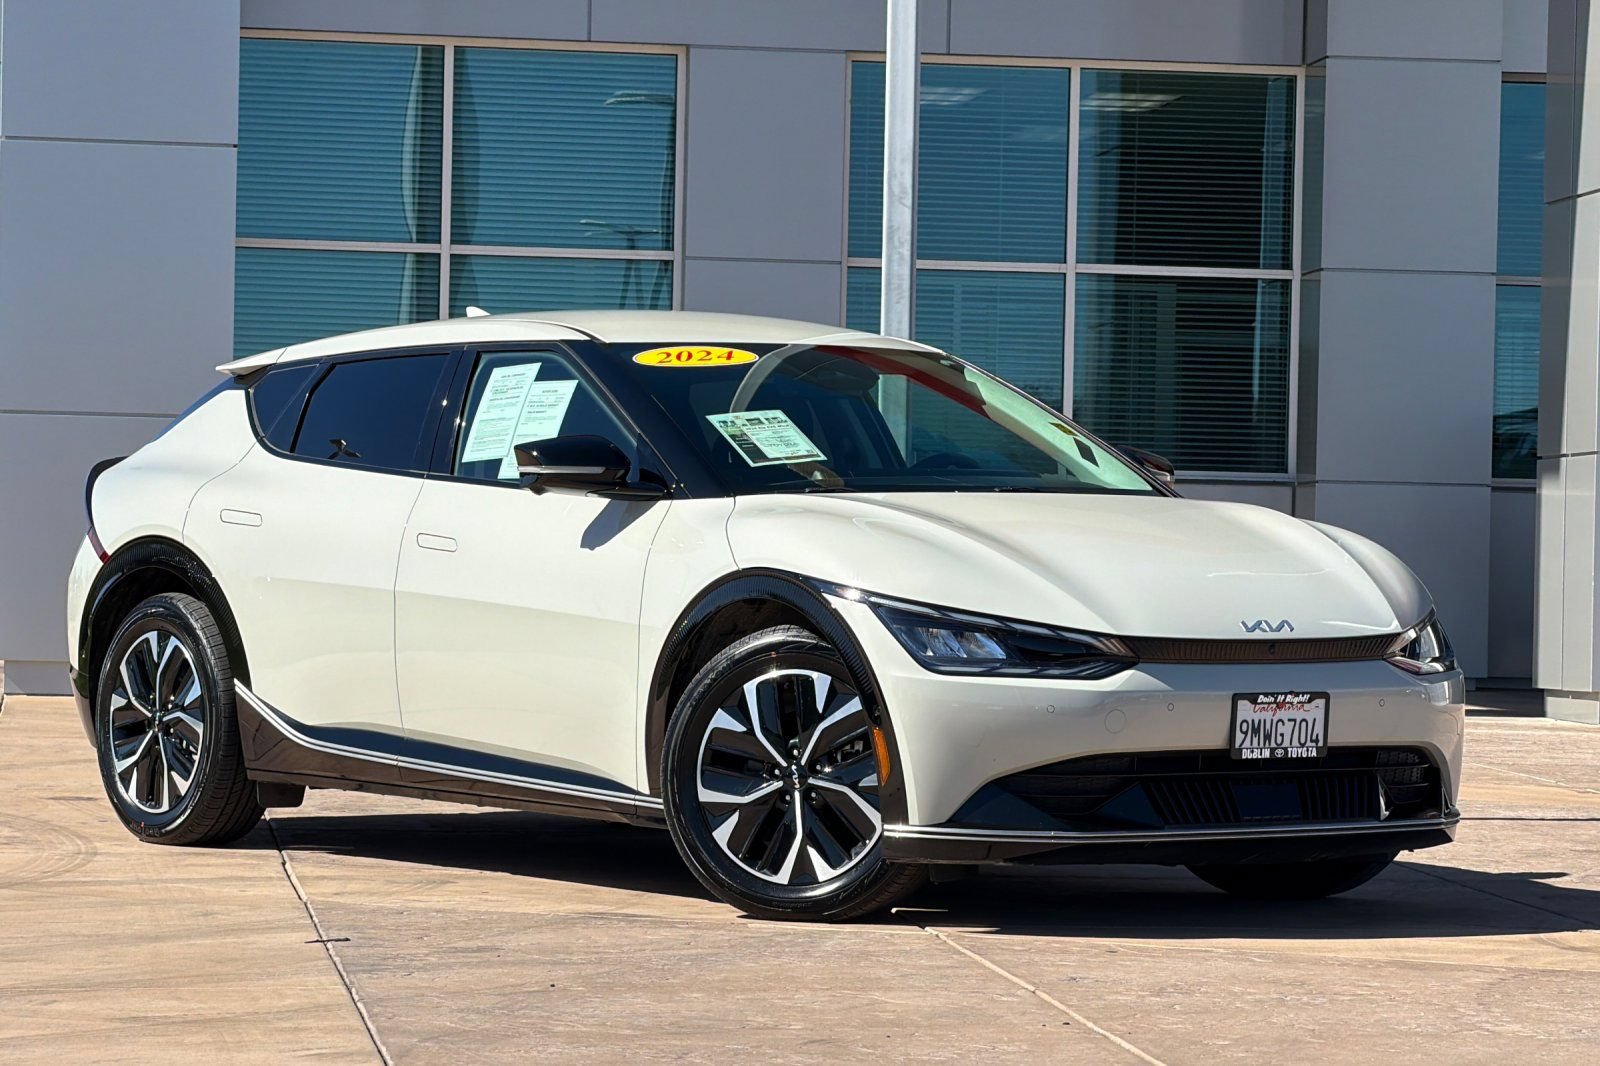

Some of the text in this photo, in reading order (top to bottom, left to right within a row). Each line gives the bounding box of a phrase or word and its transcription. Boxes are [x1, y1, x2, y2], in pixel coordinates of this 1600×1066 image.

[656, 349, 735, 364] 2024
[1277, 694, 1284, 702] It
[1285, 694, 1310, 705] Right!
[1239, 717, 1320, 748] 9MWG704
[1241, 747, 1317, 760] DUBLIN TOYOTA
